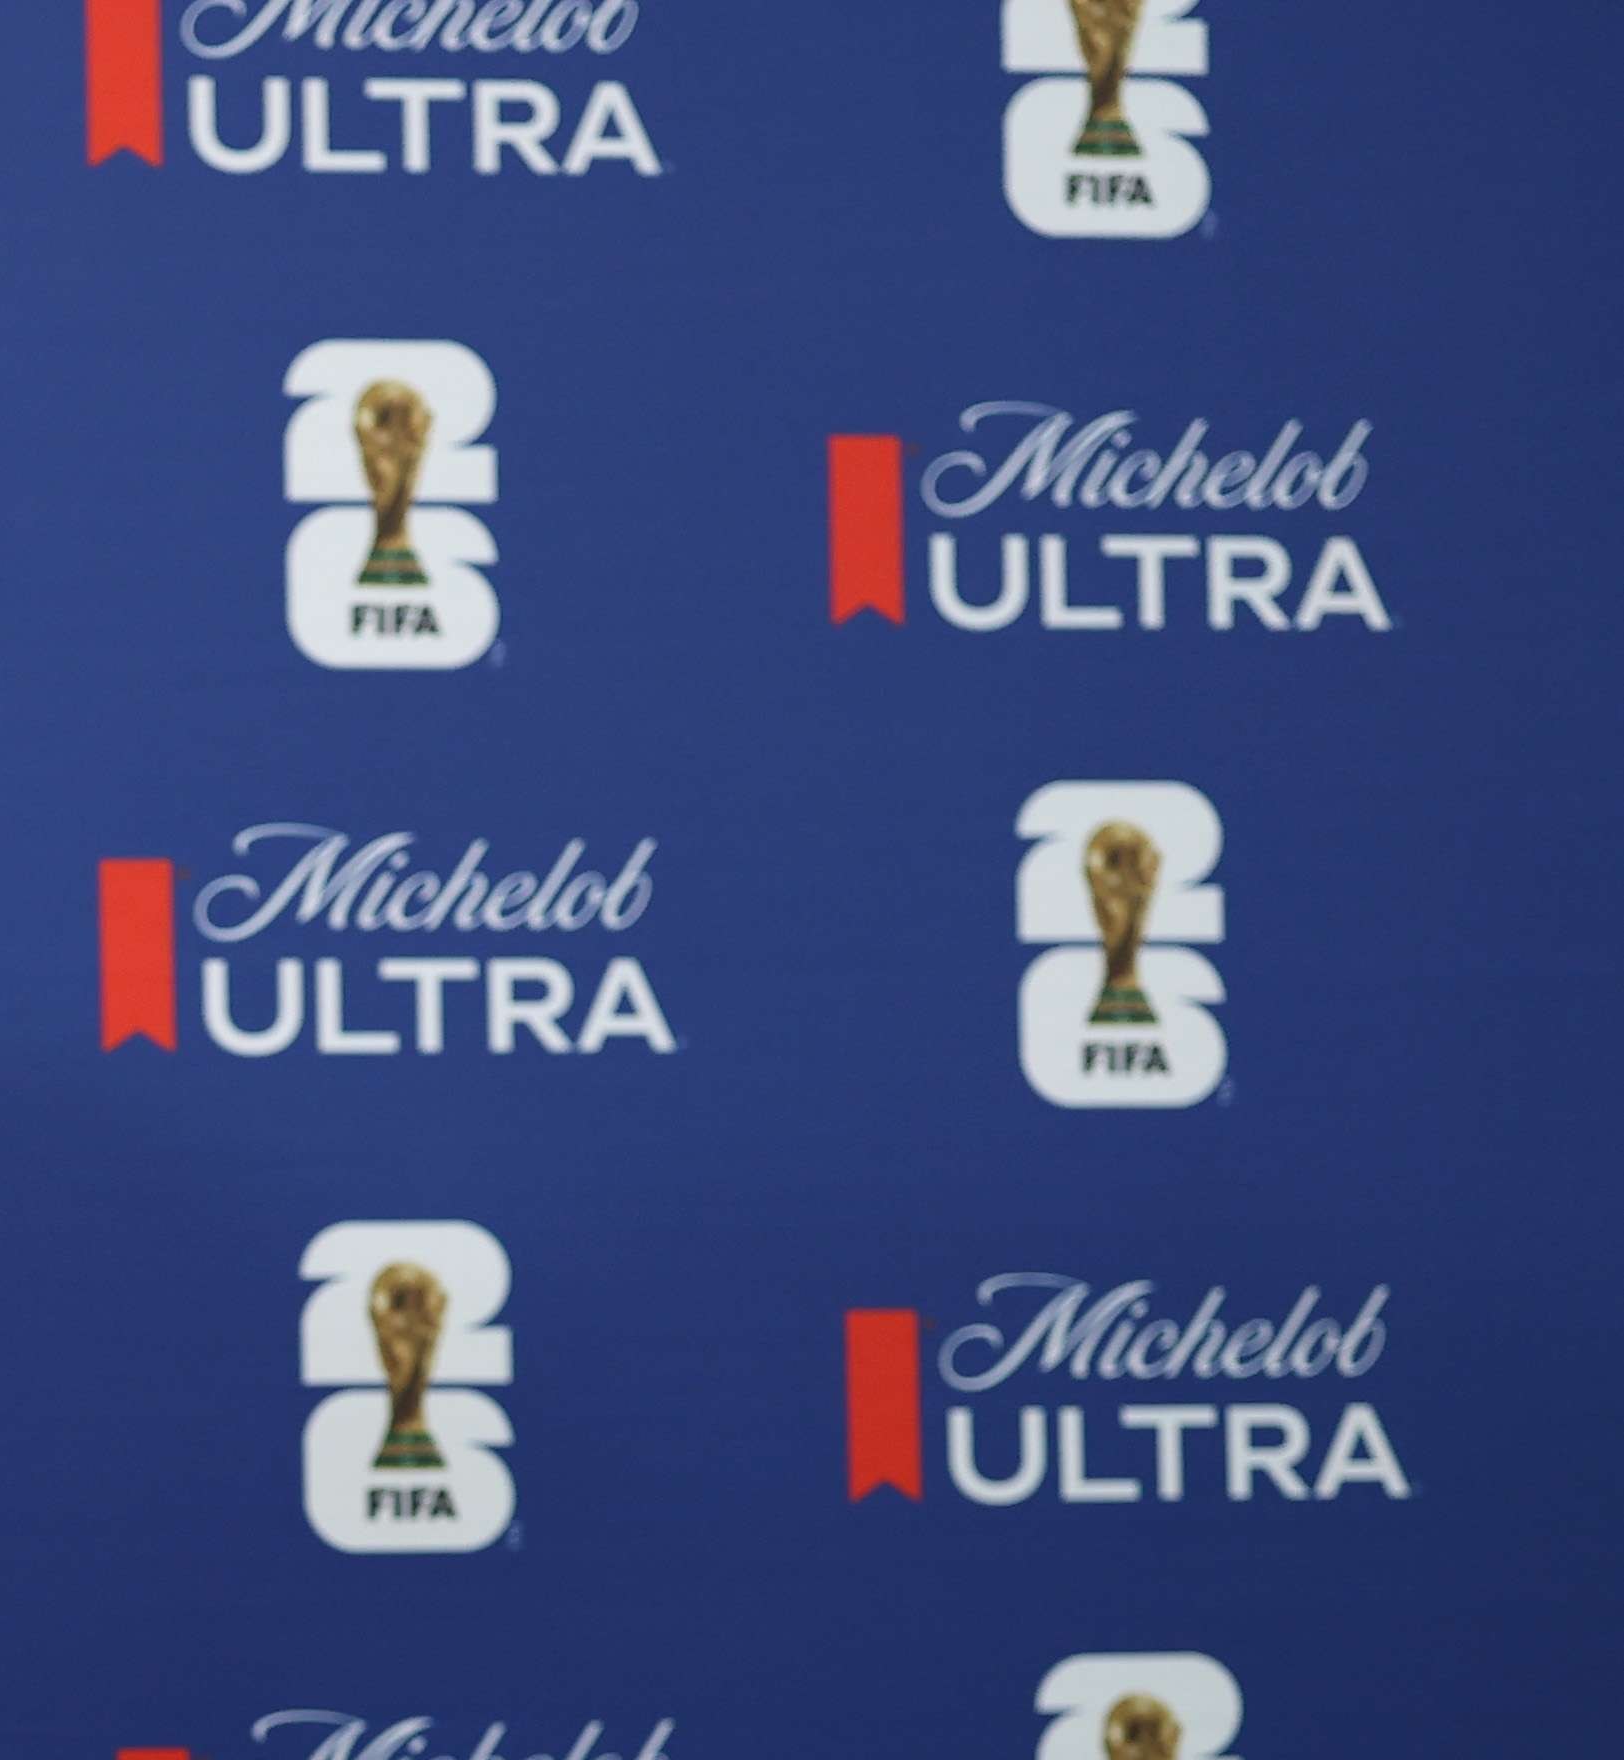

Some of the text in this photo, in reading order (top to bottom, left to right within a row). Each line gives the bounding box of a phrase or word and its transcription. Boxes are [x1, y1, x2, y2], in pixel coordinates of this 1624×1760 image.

[188, 75, 661, 176] ULTRA
[1065, 173, 1154, 206] FIFA
[923, 400, 1371, 519] Michelob
[350, 603, 441, 636] FIFA
[929, 532, 1390, 632] ULTRA
[194, 824, 656, 943] Michelob
[202, 957, 675, 1057] ULTRA
[1081, 1042, 1170, 1074] FIFA
[940, 1272, 1389, 1392] Michelob
[366, 1486, 457, 1520] FIFA
[947, 1403, 1409, 1506] ULTRA
